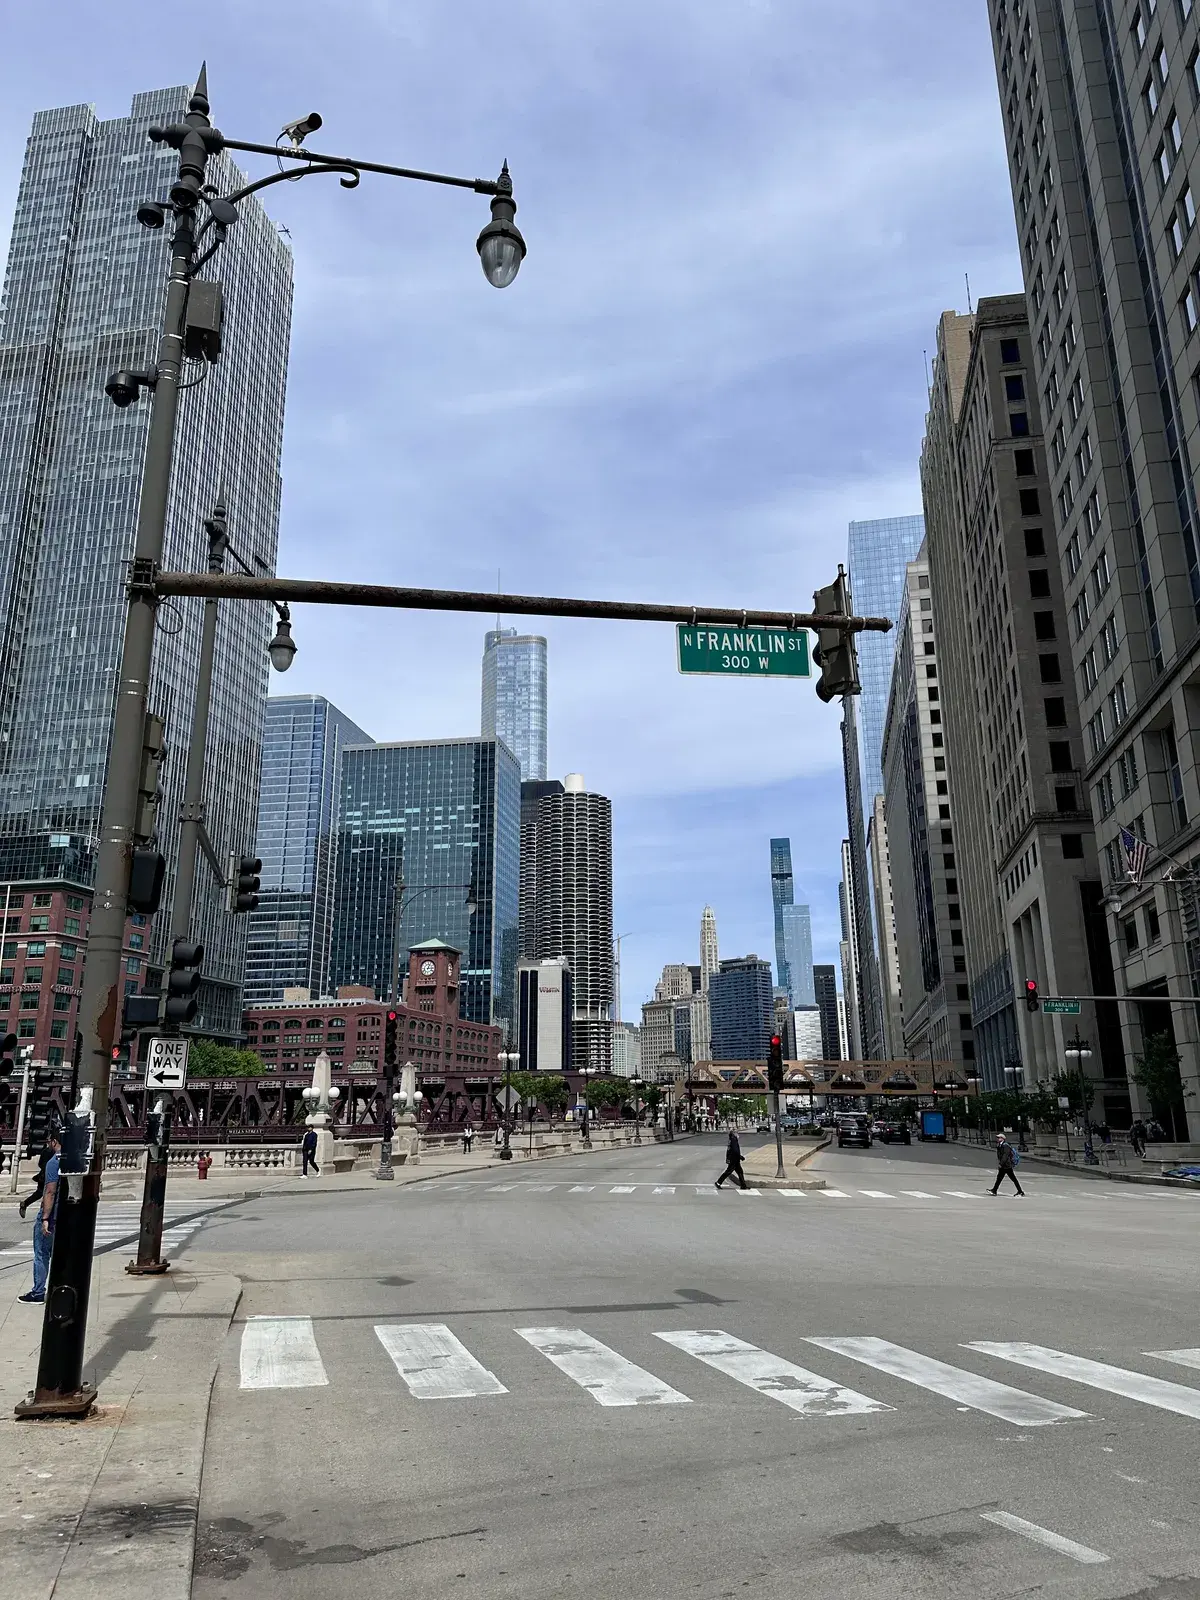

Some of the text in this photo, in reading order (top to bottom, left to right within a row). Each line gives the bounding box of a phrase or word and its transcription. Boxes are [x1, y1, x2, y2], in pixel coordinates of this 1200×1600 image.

[684, 631, 802, 653] N FRANKLIN ST
[722, 656, 769, 669] 300 W
[155, 1043, 183, 1055] ONE
[153, 1056, 182, 1069] WAY
